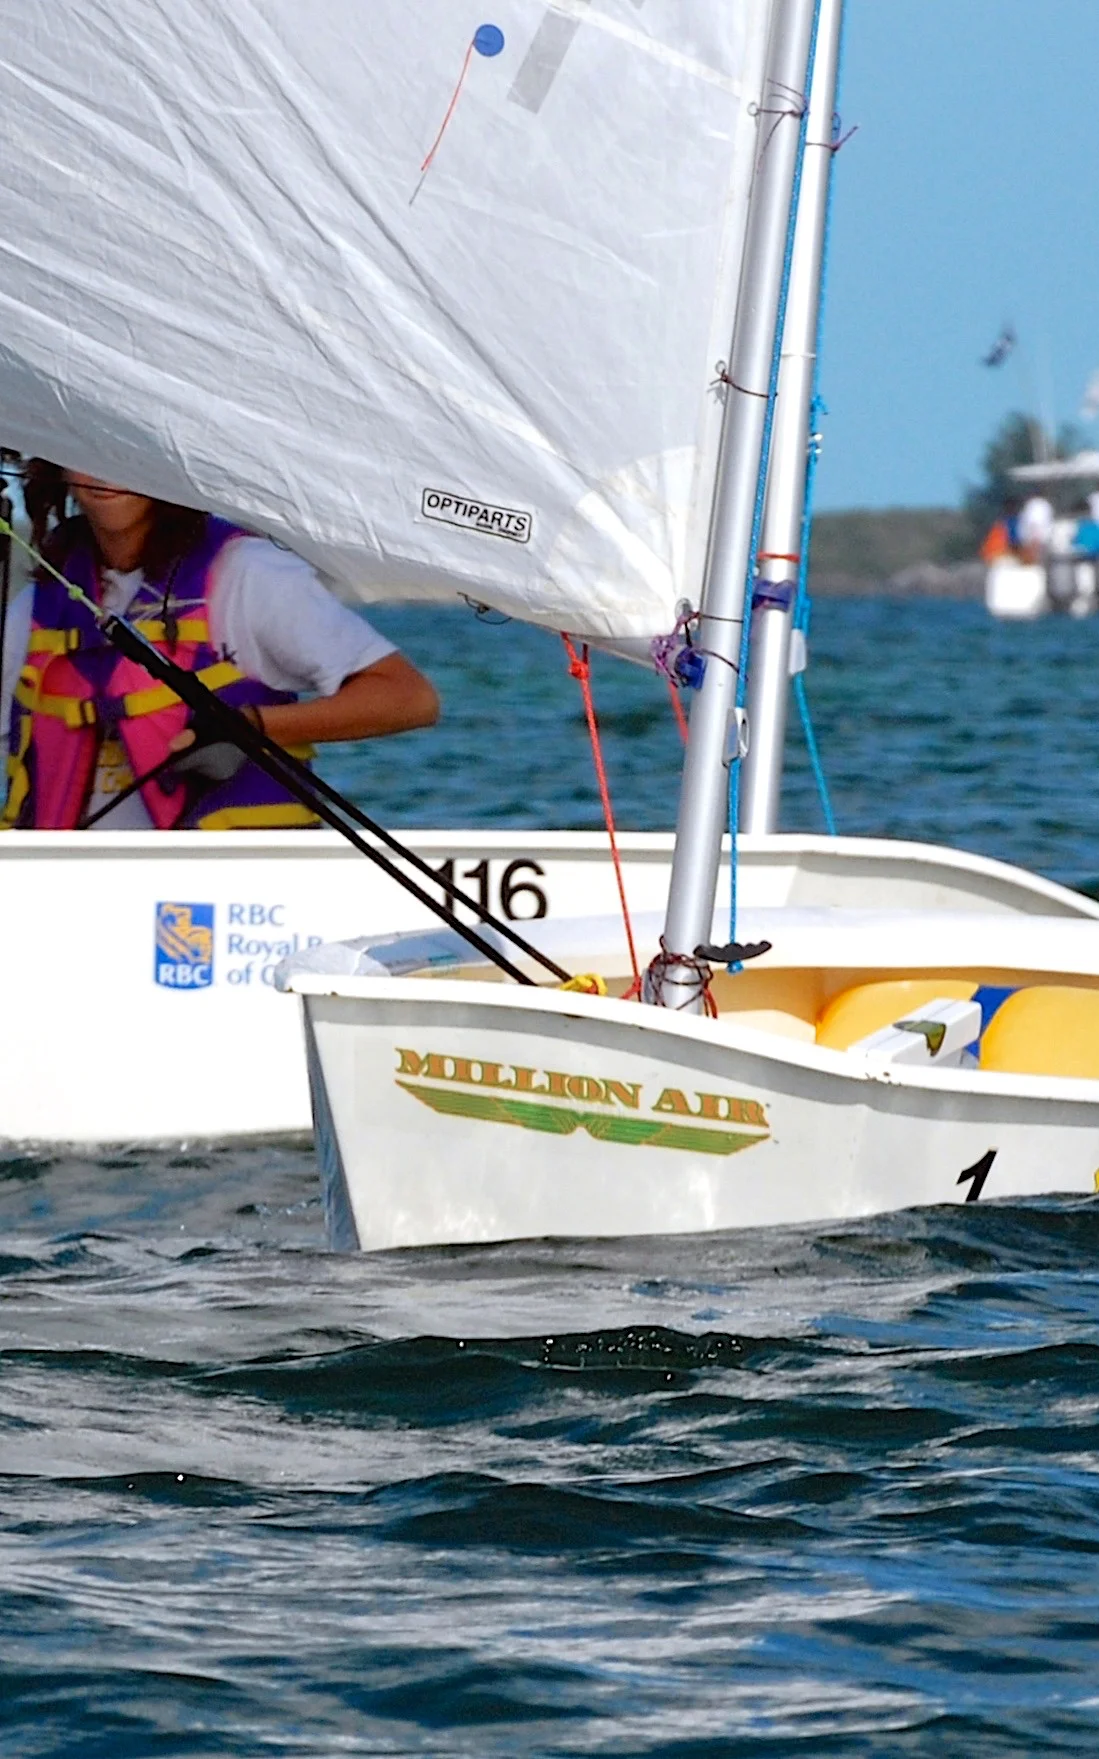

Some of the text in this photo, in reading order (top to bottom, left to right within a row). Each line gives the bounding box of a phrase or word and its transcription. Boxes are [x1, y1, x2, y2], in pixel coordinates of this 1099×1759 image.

[427, 494, 527, 531] OPTIPARTS
[434, 859, 548, 923] 116
[227, 902, 286, 926] RBC
[227, 933, 298, 962] Royal
[158, 963, 209, 986] RBC
[227, 963, 254, 984] of
[395, 1048, 769, 1128] MILLION AIR
[957, 1150, 998, 1202] 1
